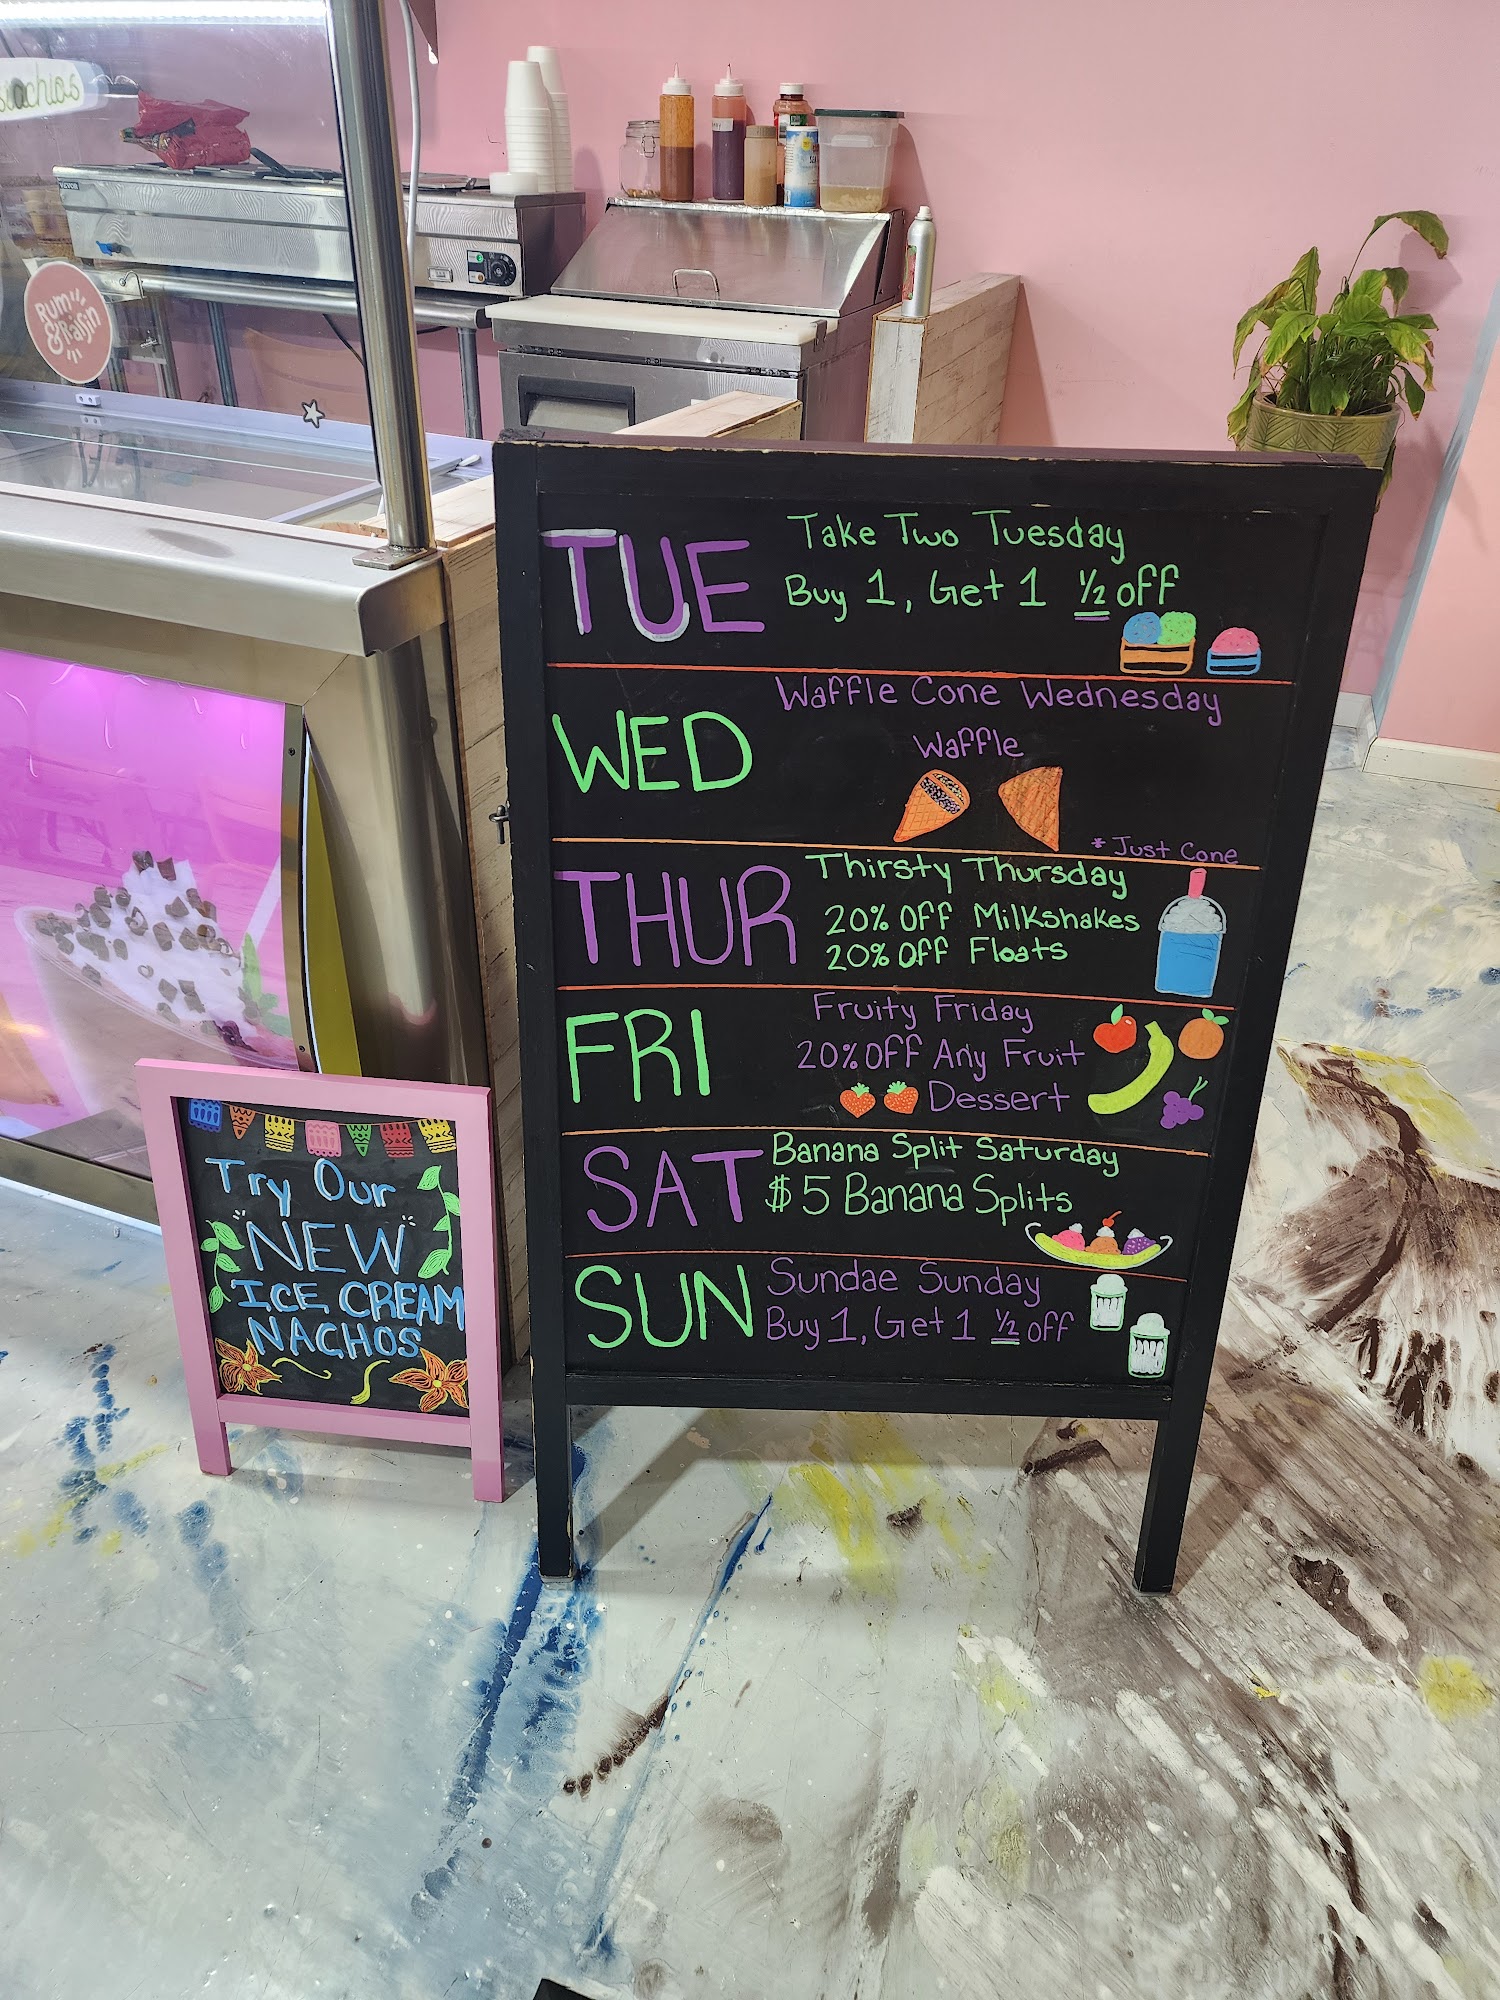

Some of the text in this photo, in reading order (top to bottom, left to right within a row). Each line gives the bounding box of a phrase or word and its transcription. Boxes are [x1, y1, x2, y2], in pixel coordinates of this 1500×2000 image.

[787, 510, 1126, 564] Take Two Tuesday
[540, 528, 765, 642] TUE
[785, 573, 848, 622] Buy
[929, 569, 1004, 606] Get
[1019, 567, 1047, 606] 1
[775, 675, 1222, 726] Waffle Cone Wednesday
[552, 709, 753, 793] WED
[912, 726, 1024, 759] Waffle
[805, 852, 1127, 899] Thirsty Thursday
[1181, 841, 1239, 865] Cone
[553, 864, 796, 968] THUR
[824, 903, 889, 935] 20%
[826, 942, 890, 971] 20%
[969, 936, 1069, 964] Floats
[813, 991, 1034, 1034] Fruity Friday
[566, 1008, 711, 1103] FRI
[933, 1038, 987, 1082] Any
[1003, 1039, 1085, 1068] Fruit
[928, 1080, 1070, 1112] Dessert
[772, 1131, 1120, 1177] Banana Split Saturday
[205, 1157, 396, 1217] Try Our
[583, 1145, 764, 1232] SAT
[844, 1172, 964, 1216] Banana
[973, 1173, 1073, 1226] Splits
[246, 1221, 405, 1274] NEW
[230, 1279, 465, 1331] ICE CREAM
[574, 1264, 754, 1349] SUN
[767, 1257, 1041, 1307] Sundae Sunday
[248, 1316, 422, 1359] NACHOS
[766, 1305, 821, 1351] Buy
[875, 1307, 944, 1339] Get
[952, 1308, 976, 1341] 1
